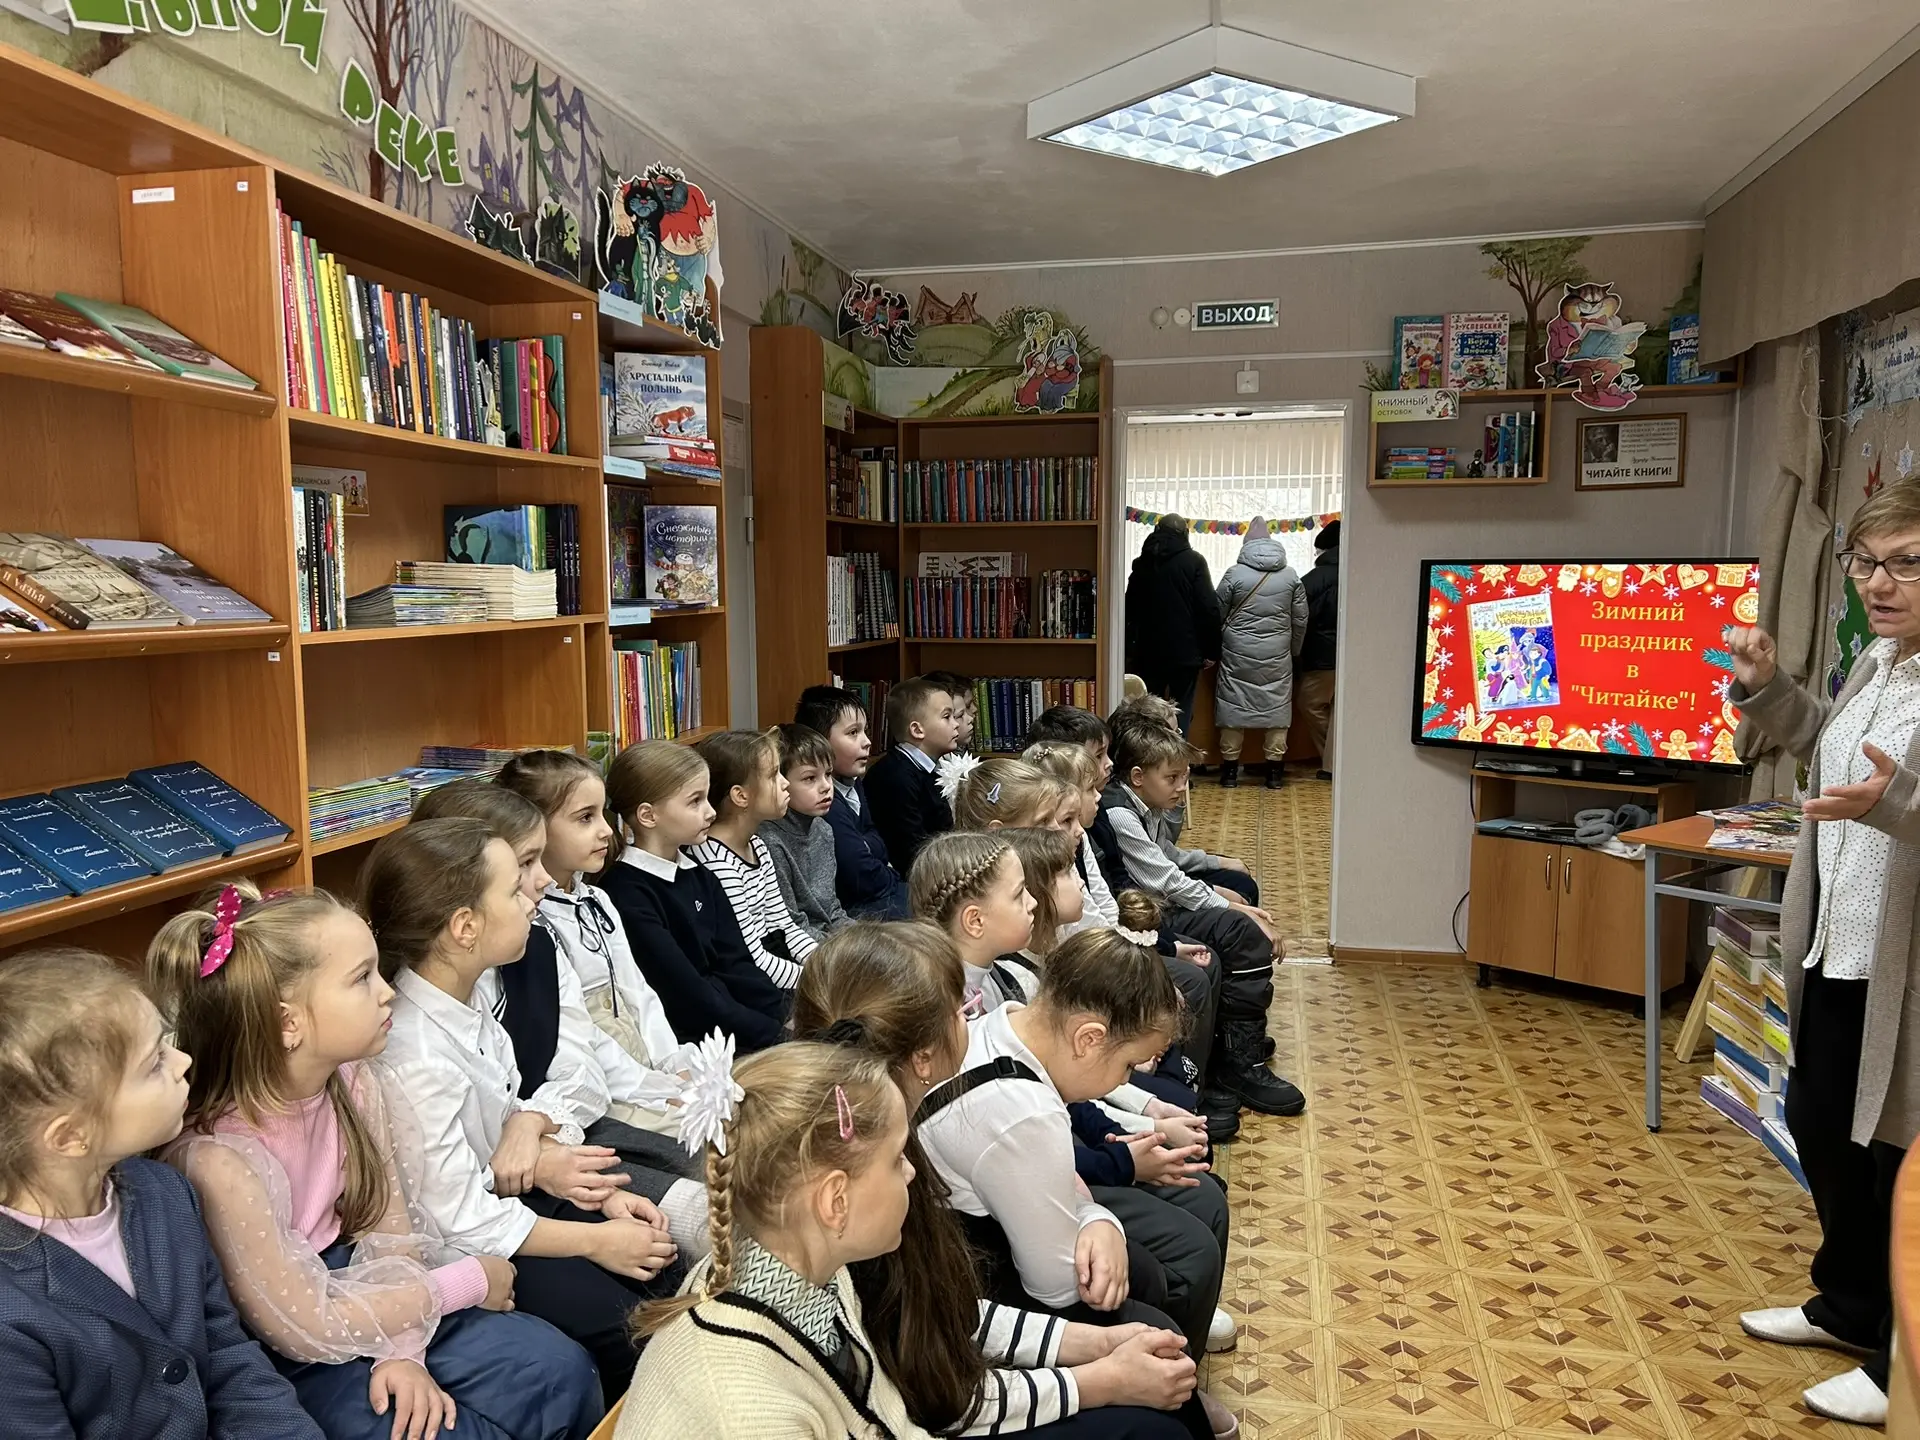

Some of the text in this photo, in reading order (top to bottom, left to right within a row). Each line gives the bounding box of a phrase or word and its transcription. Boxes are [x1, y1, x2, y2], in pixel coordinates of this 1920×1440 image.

[341, 57, 464, 186] РЕКЕ
[1202, 305, 1271, 323] ВЫХОД
[630, 372, 693, 384] ХРУСТАЛЬНАЯ
[641, 383, 682, 395] ПОЛЫНЬ
[1377, 395, 1428, 407] КНИЖНЫЙ
[1377, 408, 1412, 417] ОСТРОВОК
[1586, 466, 1672, 478] ЧИТАЙТЕ КНИГИ!
[656, 522, 712, 536] Снежные
[665, 534, 709, 546] истории
[14, 576, 46, 604] ВЧЕРА
[1592, 600, 1685, 621] Зимний
[1580, 633, 1694, 653] праздник
[1626, 664, 1639, 678] в
[1571, 684, 1696, 711] "Читайке"!
